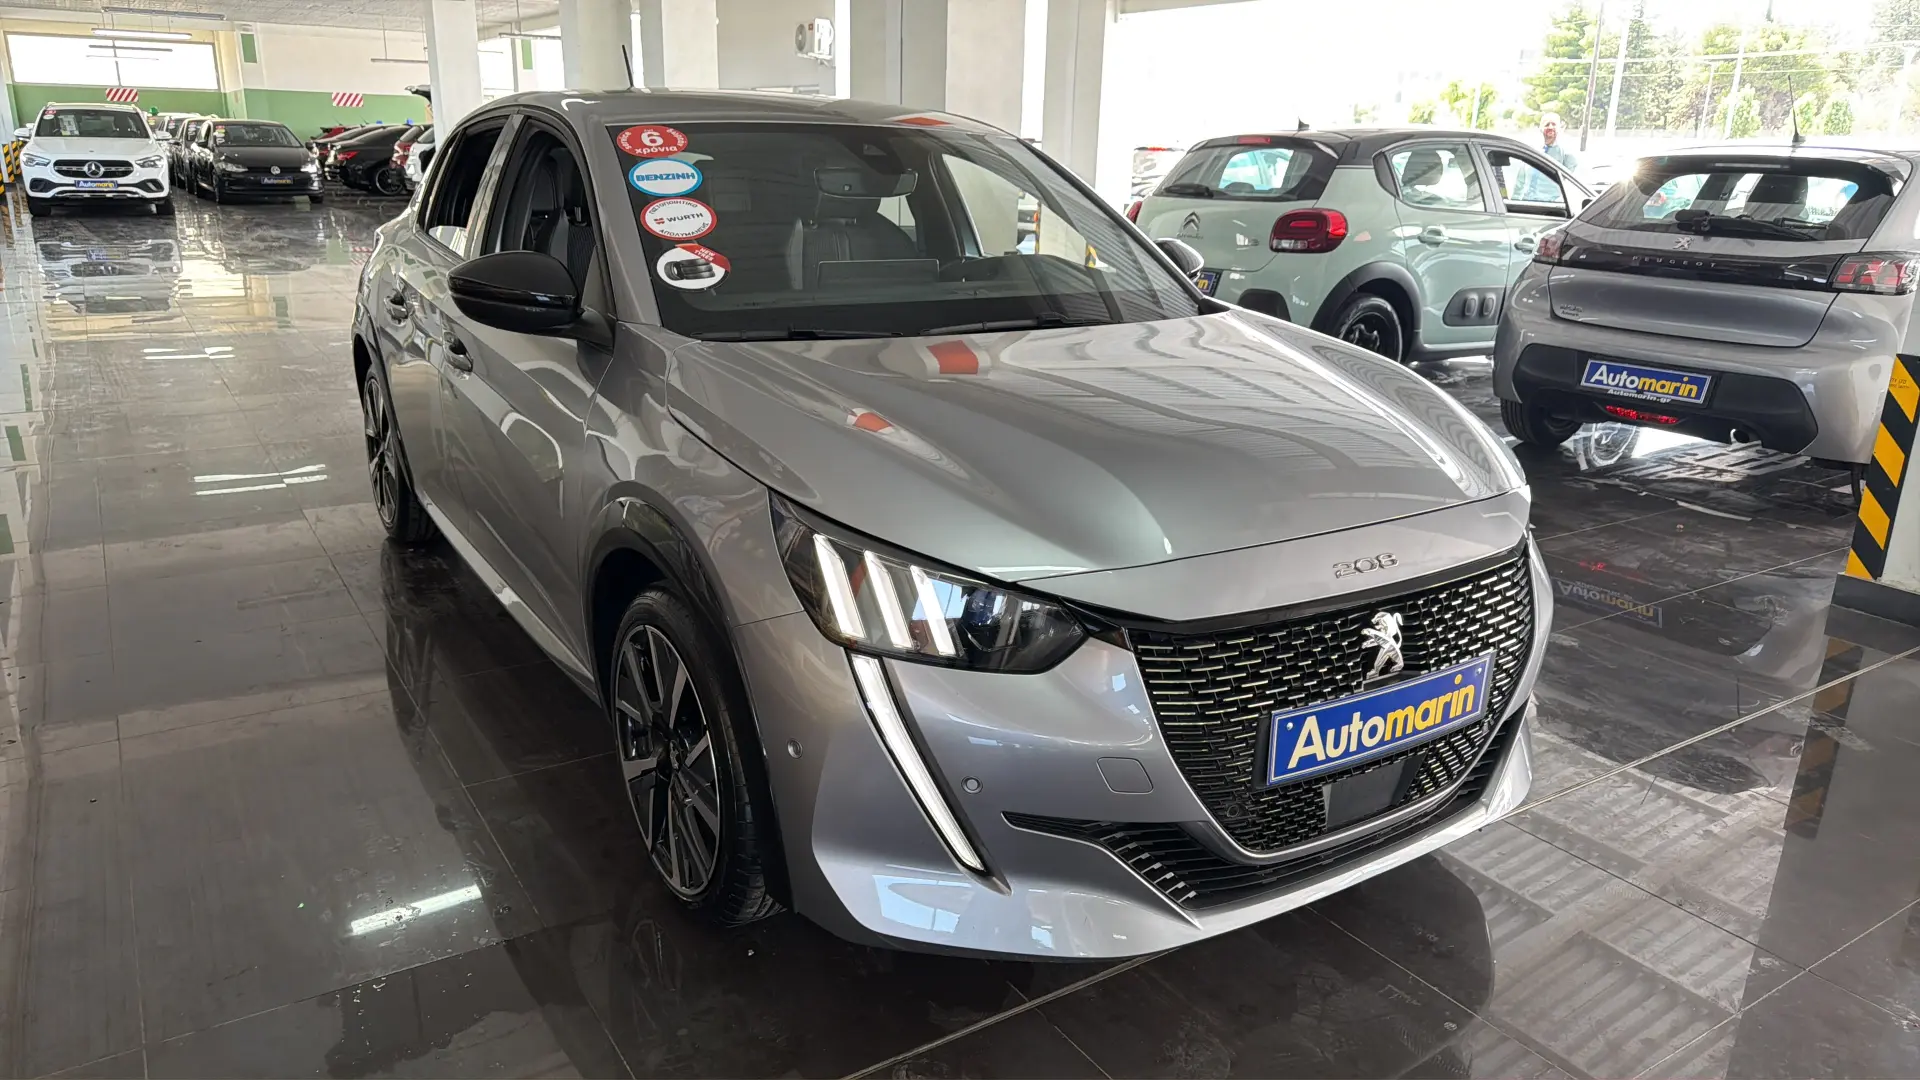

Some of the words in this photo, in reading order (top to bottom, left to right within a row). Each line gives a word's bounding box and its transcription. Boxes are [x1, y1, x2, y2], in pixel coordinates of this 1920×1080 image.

[641, 131, 664, 147] 6
[635, 146, 678, 155] χρόνια
[699, 247, 716, 257] NEW
[1632, 255, 1717, 268] PEUGEOT
[1590, 364, 1698, 398] Automarin
[1607, 388, 1672, 404] Automarin.gr
[1332, 552, 1399, 579] 208
[1287, 674, 1475, 769] Automarin
